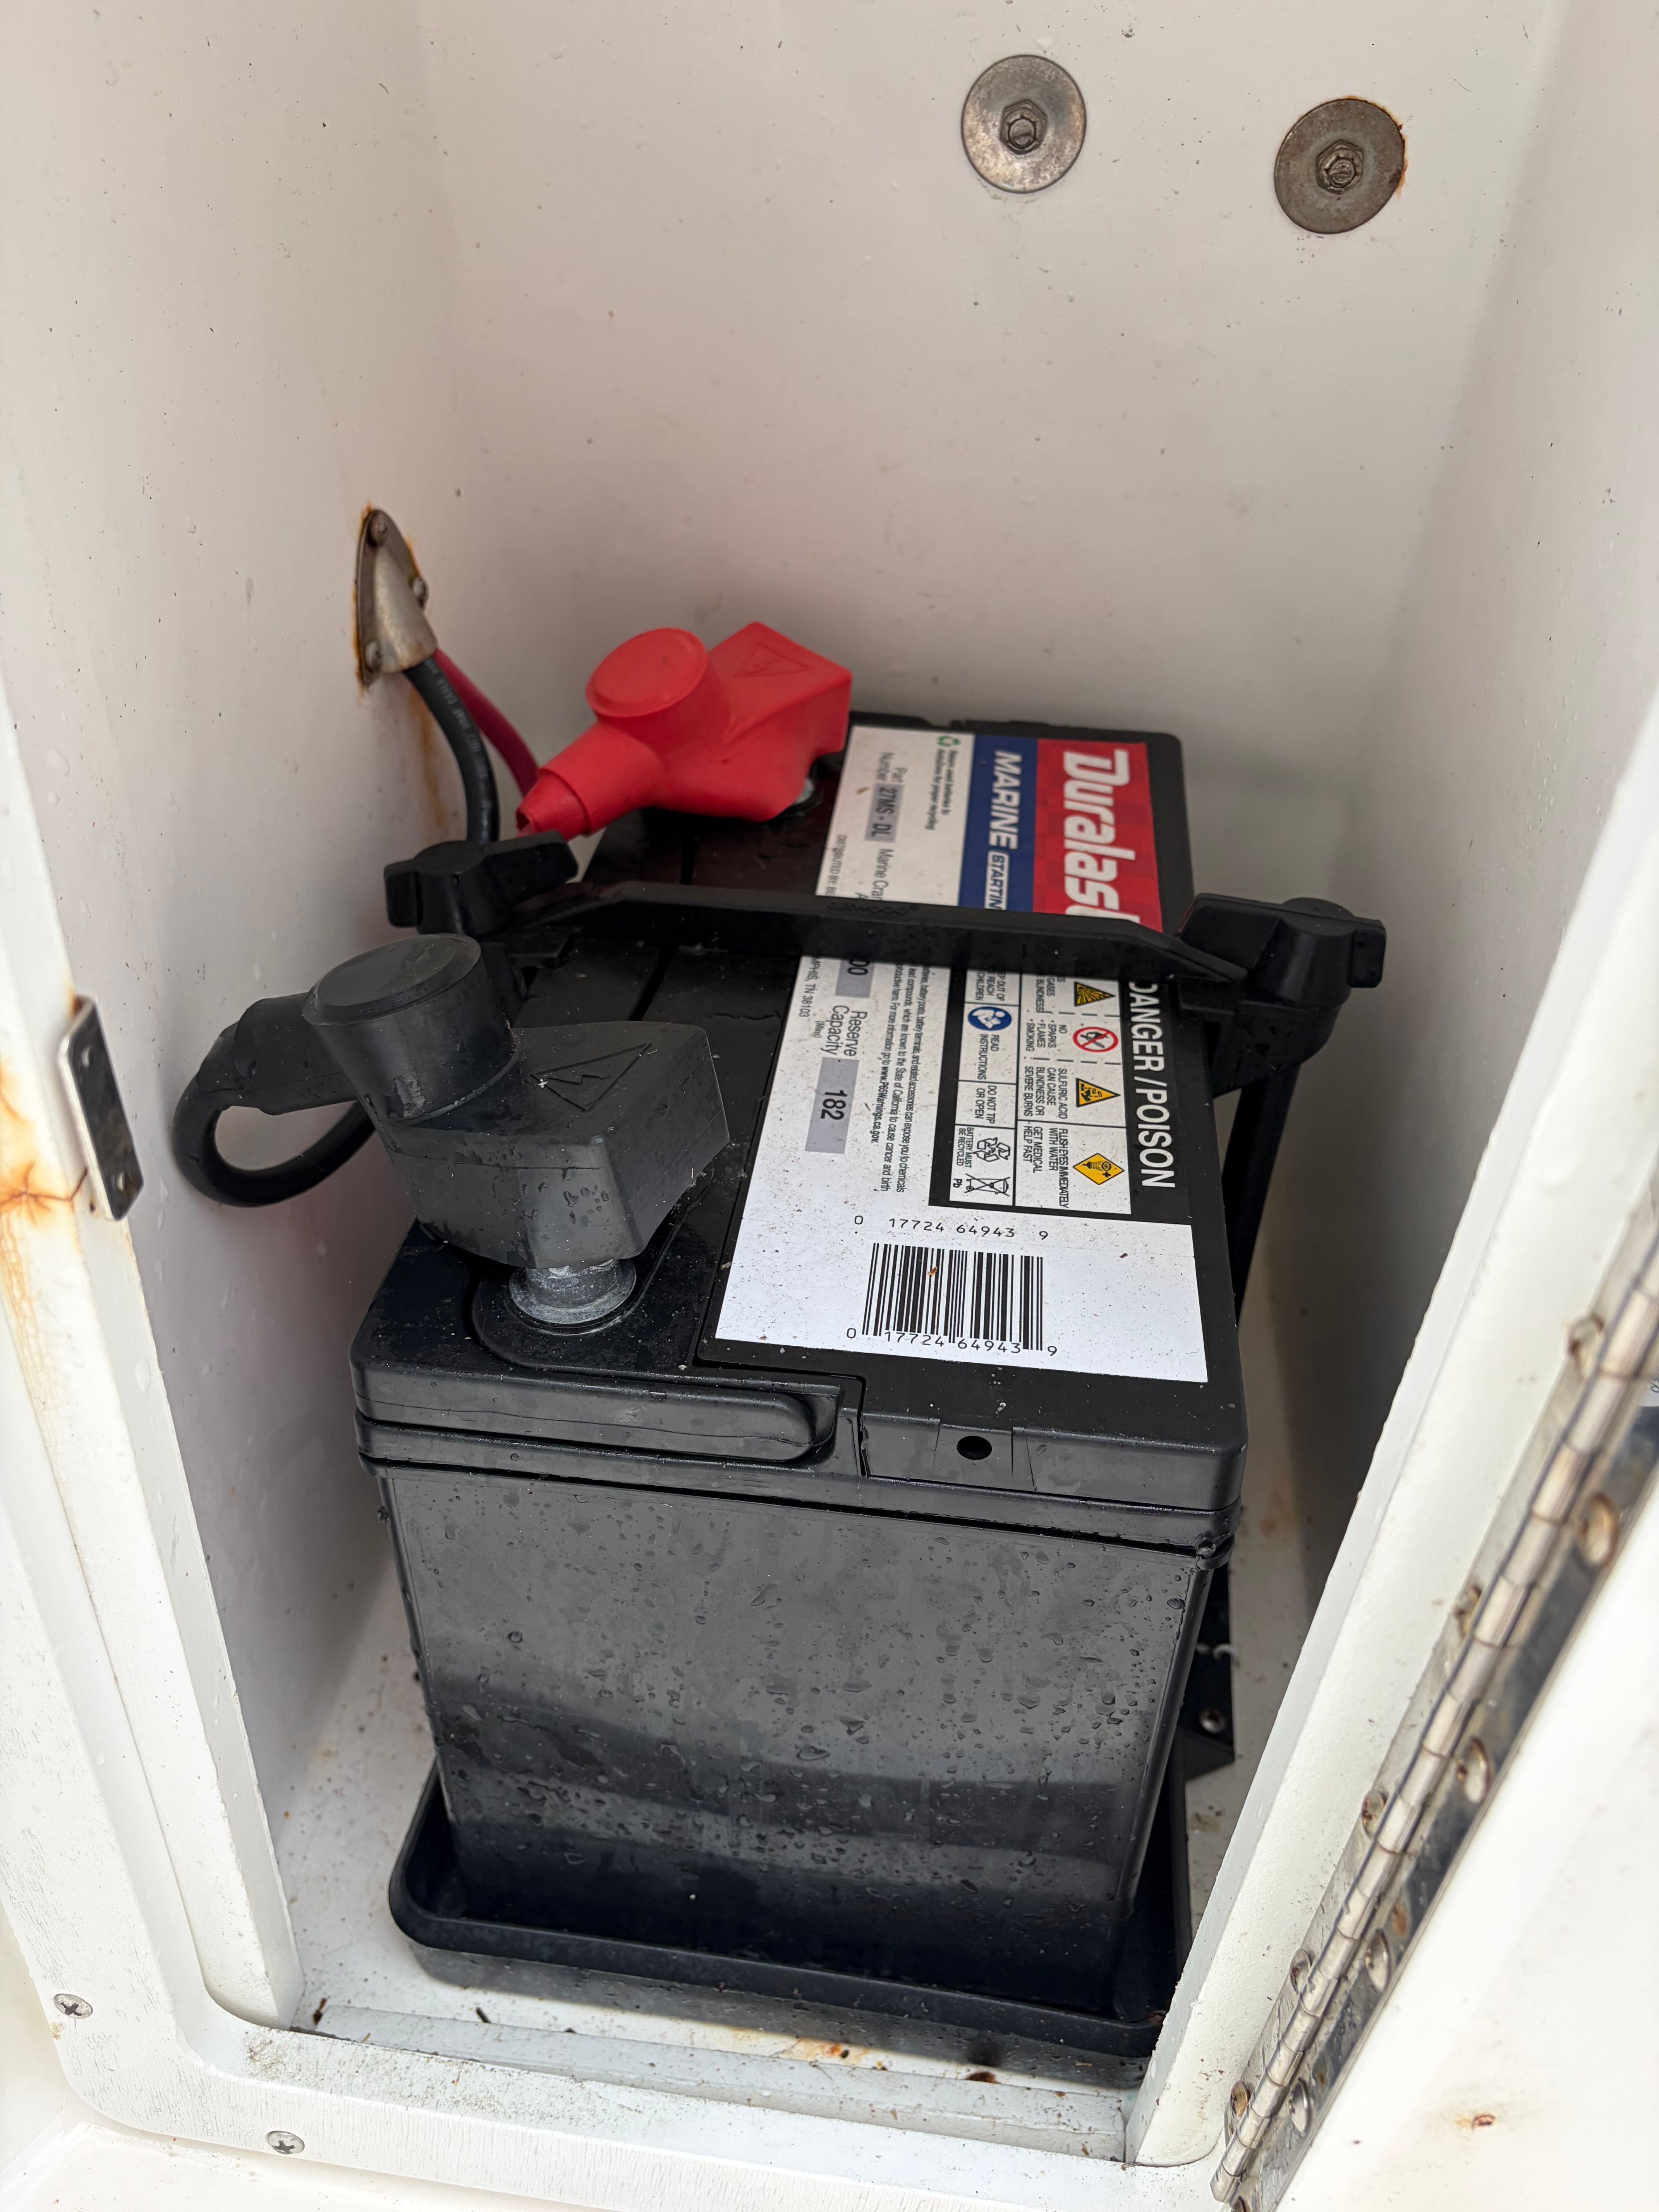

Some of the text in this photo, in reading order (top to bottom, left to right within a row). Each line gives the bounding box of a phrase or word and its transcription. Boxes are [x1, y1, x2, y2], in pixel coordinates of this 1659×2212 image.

[877, 752, 895, 781] Number
[892, 768, 908, 783] Part
[875, 787, 898, 814] 27MS
[989, 750, 1022, 849] MARINE
[871, 823, 893, 837] DL
[874, 848, 895, 878] Marine
[804, 984, 816, 994] TN
[975, 972, 985, 1000] CHILDREN
[986, 976, 996, 996] REACH
[996, 994, 1005, 1002] OF
[997, 981, 1006, 992] OUT
[1046, 978, 1055, 997] GASES
[799, 996, 814, 1017] 38103
[888, 1012, 897, 1023] more
[890, 1003, 900, 1011] For
[902, 1009, 913, 1023] which
[811, 1021, 825, 1038] (Mins)
[820, 1005, 850, 1054] Capacity
[843, 1011, 867, 1056] Reserve
[884, 1024, 897, 1051] information
[901, 1024, 909, 1032] are
[1026, 1022, 1036, 1052] SMOKING
[1037, 1023, 1046, 1048] FLAMES
[1048, 1024, 1057, 1048] SPARKS
[1059, 1025, 1067, 1034] NO
[898, 1033, 910, 1049] known
[990, 1035, 999, 1051] READ
[896, 1058, 907, 1066] the
[911, 1055, 921, 1065] and
[977, 1034, 989, 1080] INSTRUCTIONS
[895, 1067, 907, 1081] State
[909, 1065, 920, 1081] related
[905, 1082, 917, 1111] accessories
[1024, 1066, 1034, 1116] SEVERE BURNS
[1036, 1067, 1045, 1116] BLINDNESS OR
[1047, 1068, 1056, 1106] CAN CAUSE
[1058, 1068, 1068, 1119] SULFURIC ACID
[820, 1090, 848, 1120] 182
[890, 1090, 903, 1115] California
[974, 1088, 985, 1118] OR OPEN
[986, 1085, 997, 1123] DO NOT TIP
[905, 1112, 914, 1122] can
[887, 1124, 896, 1141] cause
[900, 1123, 912, 1143] expose
[1023, 1126, 1033, 1163] HELP FAST
[884, 1142, 894, 1163] cancer
[899, 1144, 910, 1155] you
[956, 1128, 966, 1166] BE RECYCLED
[964, 1127, 974, 1168] BATTERY MUST
[1033, 1127, 1043, 1173] GET MEDICAL
[1049, 1128, 1058, 1171] WITH WATER
[882, 1164, 893, 1176] and
[896, 1163, 909, 1192] chemicals
[1059, 1128, 1069, 1209] FLUSH EYES IMMEDIATELY
[880, 1177, 892, 1191] birth
[953, 1178, 963, 1188] Pb
[854, 1215, 1049, 1240] 0 17724 64943 9
[846, 1328, 1058, 1357] 0 17724 64943 9
